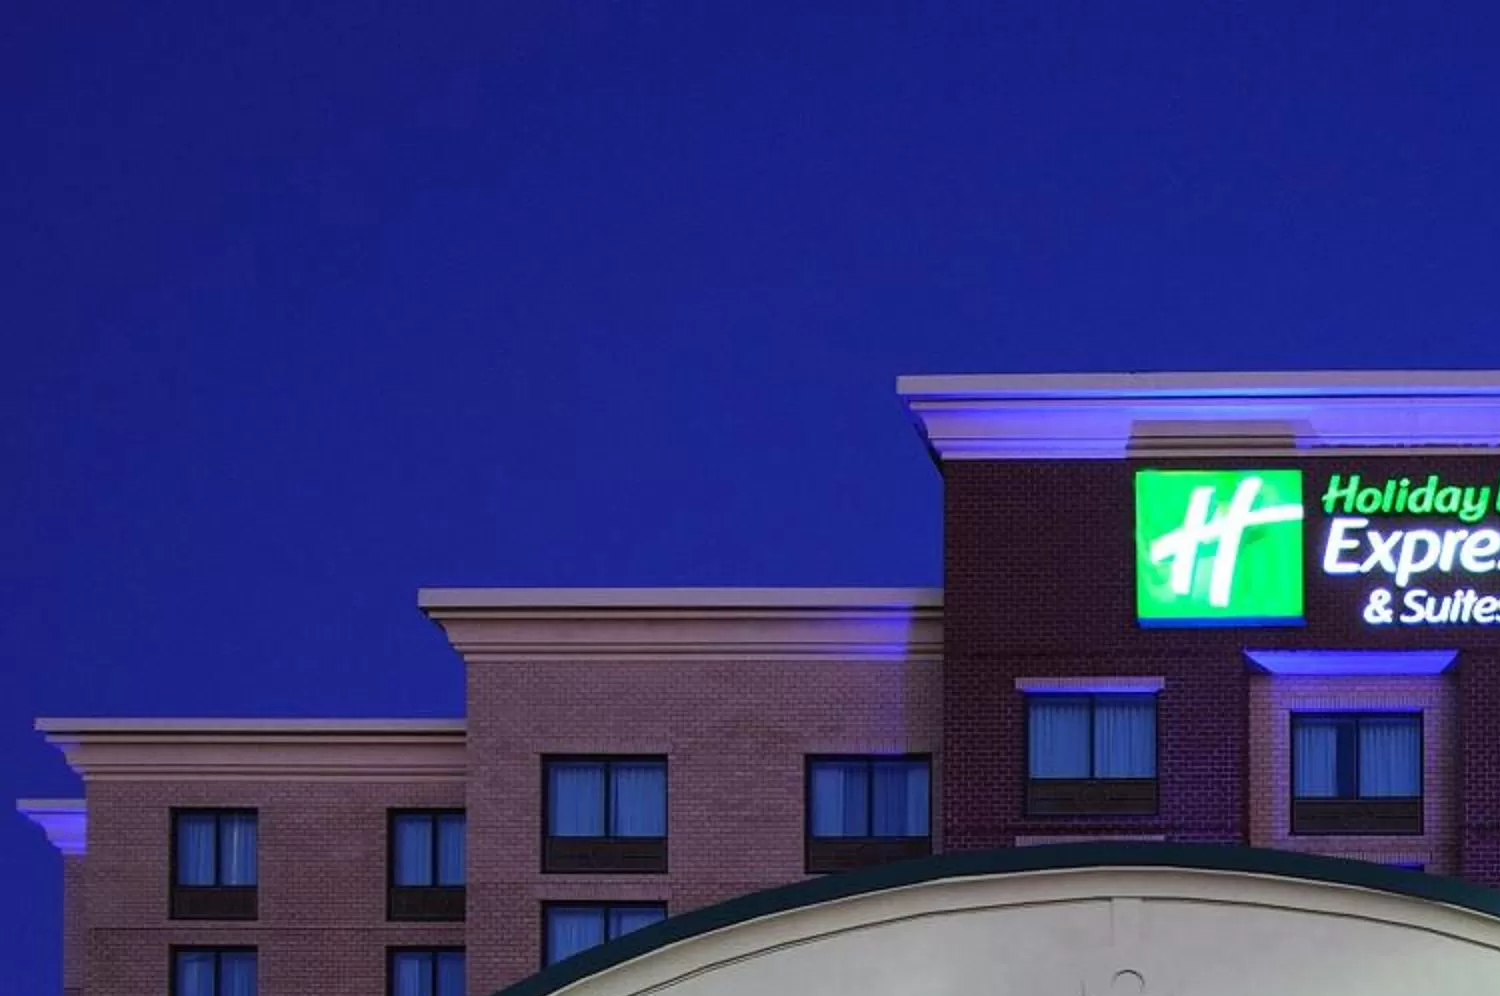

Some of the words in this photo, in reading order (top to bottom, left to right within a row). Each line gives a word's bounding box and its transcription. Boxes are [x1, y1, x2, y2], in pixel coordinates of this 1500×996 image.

[1322, 475, 1488, 522] Holiday
[1151, 476, 1304, 608] H
[1362, 588, 1394, 624] &
